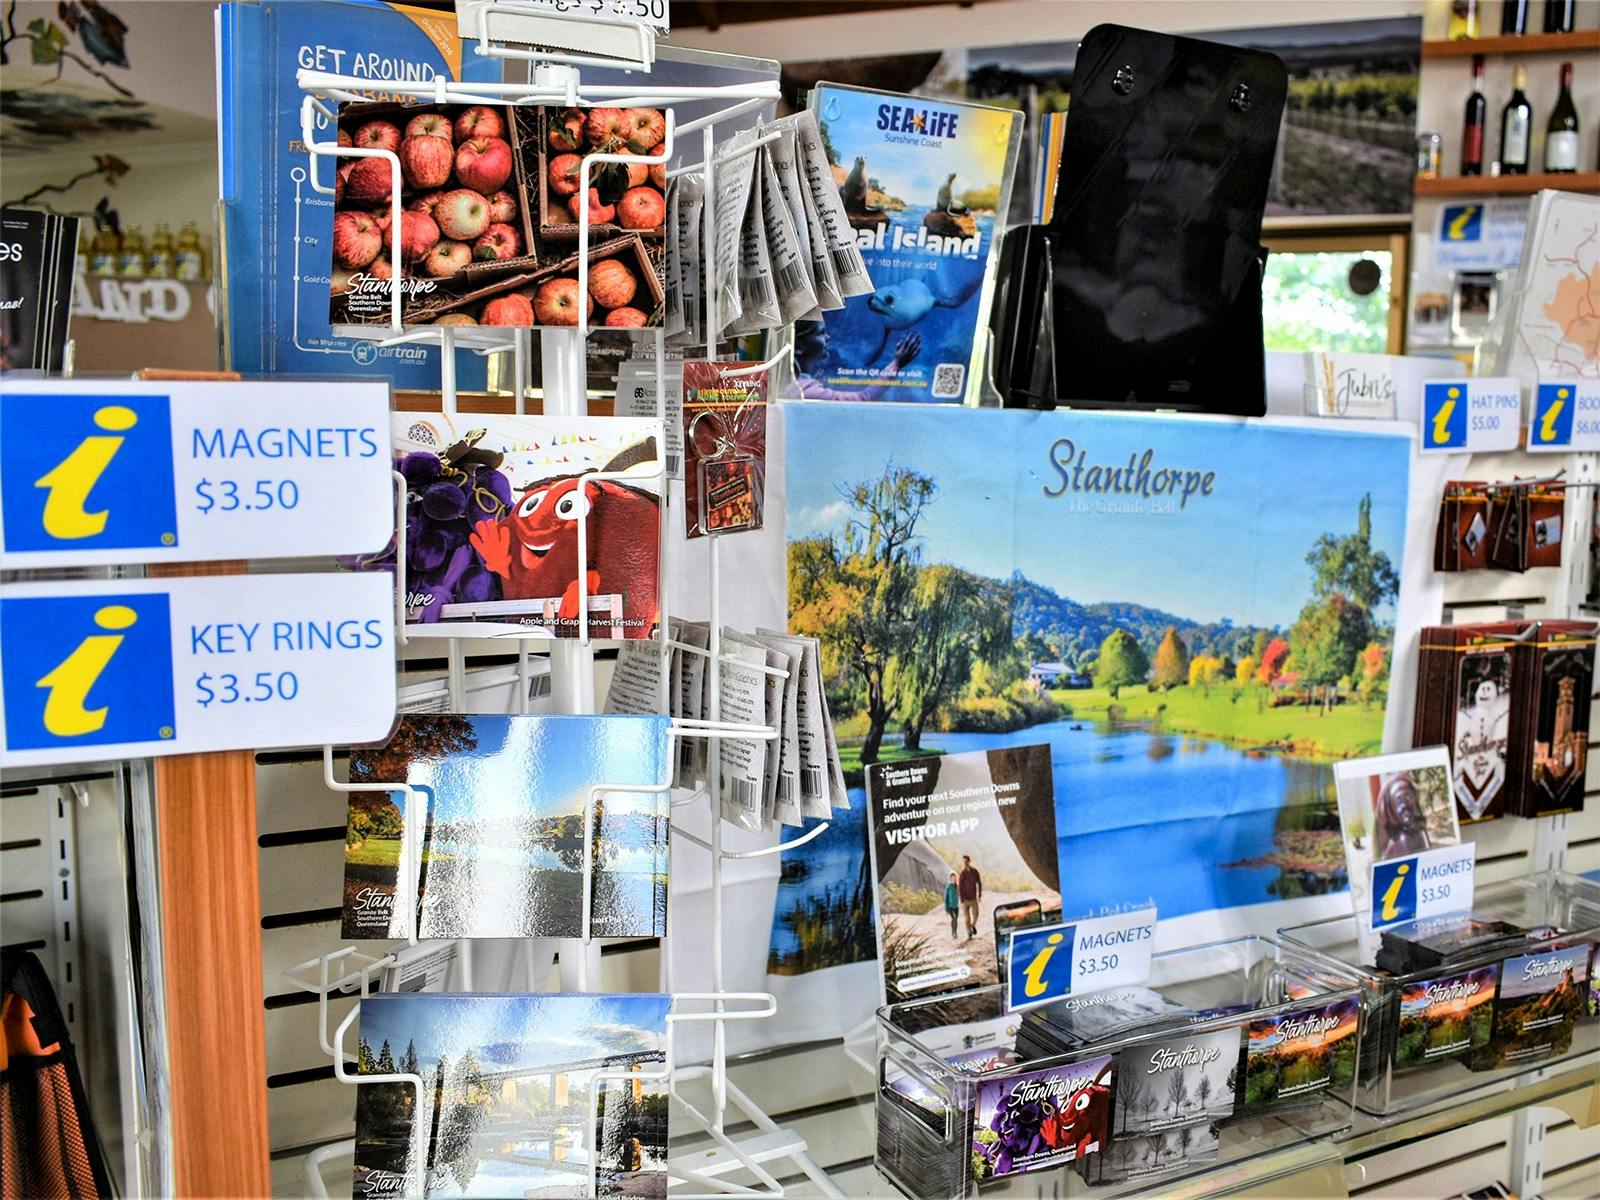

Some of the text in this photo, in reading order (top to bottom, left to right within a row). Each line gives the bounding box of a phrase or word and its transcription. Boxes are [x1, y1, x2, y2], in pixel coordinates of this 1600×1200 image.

[298, 45, 435, 82] GET AROUND
[877, 104, 916, 132] SEA
[884, 133, 942, 149] Sunshine Coast
[304, 198, 335, 207] Brisbane
[304, 236, 319, 246] City
[892, 225, 982, 258] Island
[304, 276, 319, 284] Gold
[345, 273, 437, 301] Stantorpe
[379, 346, 428, 360] airtrain
[837, 367, 854, 376] Scan
[855, 368, 868, 376] the
[1471, 394, 1518, 410] HAT PINS
[1471, 415, 1500, 431] $5.00
[191, 427, 379, 460] MAGNETS
[1043, 438, 1216, 509] Stanthorpe
[195, 477, 299, 515] $3.50
[1069, 498, 1176, 516] The Granite Belt
[519, 617, 543, 627] Apple
[544, 618, 560, 626] and
[560, 617, 580, 628] Grap
[615, 618, 645, 627] Festival
[191, 619, 384, 655] KEY RINGS
[195, 671, 299, 708] $3.50
[885, 766, 928, 780] Southern Downs
[892, 777, 911, 786] Granite
[912, 774, 923, 784] Belt
[883, 782, 1020, 810] Find your next Southern Downs
[884, 808, 932, 824] adventure
[932, 806, 945, 816] on
[946, 804, 962, 814] our
[998, 796, 1017, 806] new
[885, 817, 980, 846] VISITOR APP
[1420, 857, 1473, 881] MAGNETS
[1421, 885, 1451, 904] $3.50
[1079, 924, 1152, 951] MAGNETS
[1078, 954, 1119, 977] $3.50
[1275, 1014, 1340, 1045] Stanthorpe
[1147, 1044, 1221, 1073] Stanthorpe
[1008, 1075, 1088, 1114] Stanthorpe
[1012, 1154, 1034, 1163] Southern
[1051, 1143, 1077, 1155] Queensland
